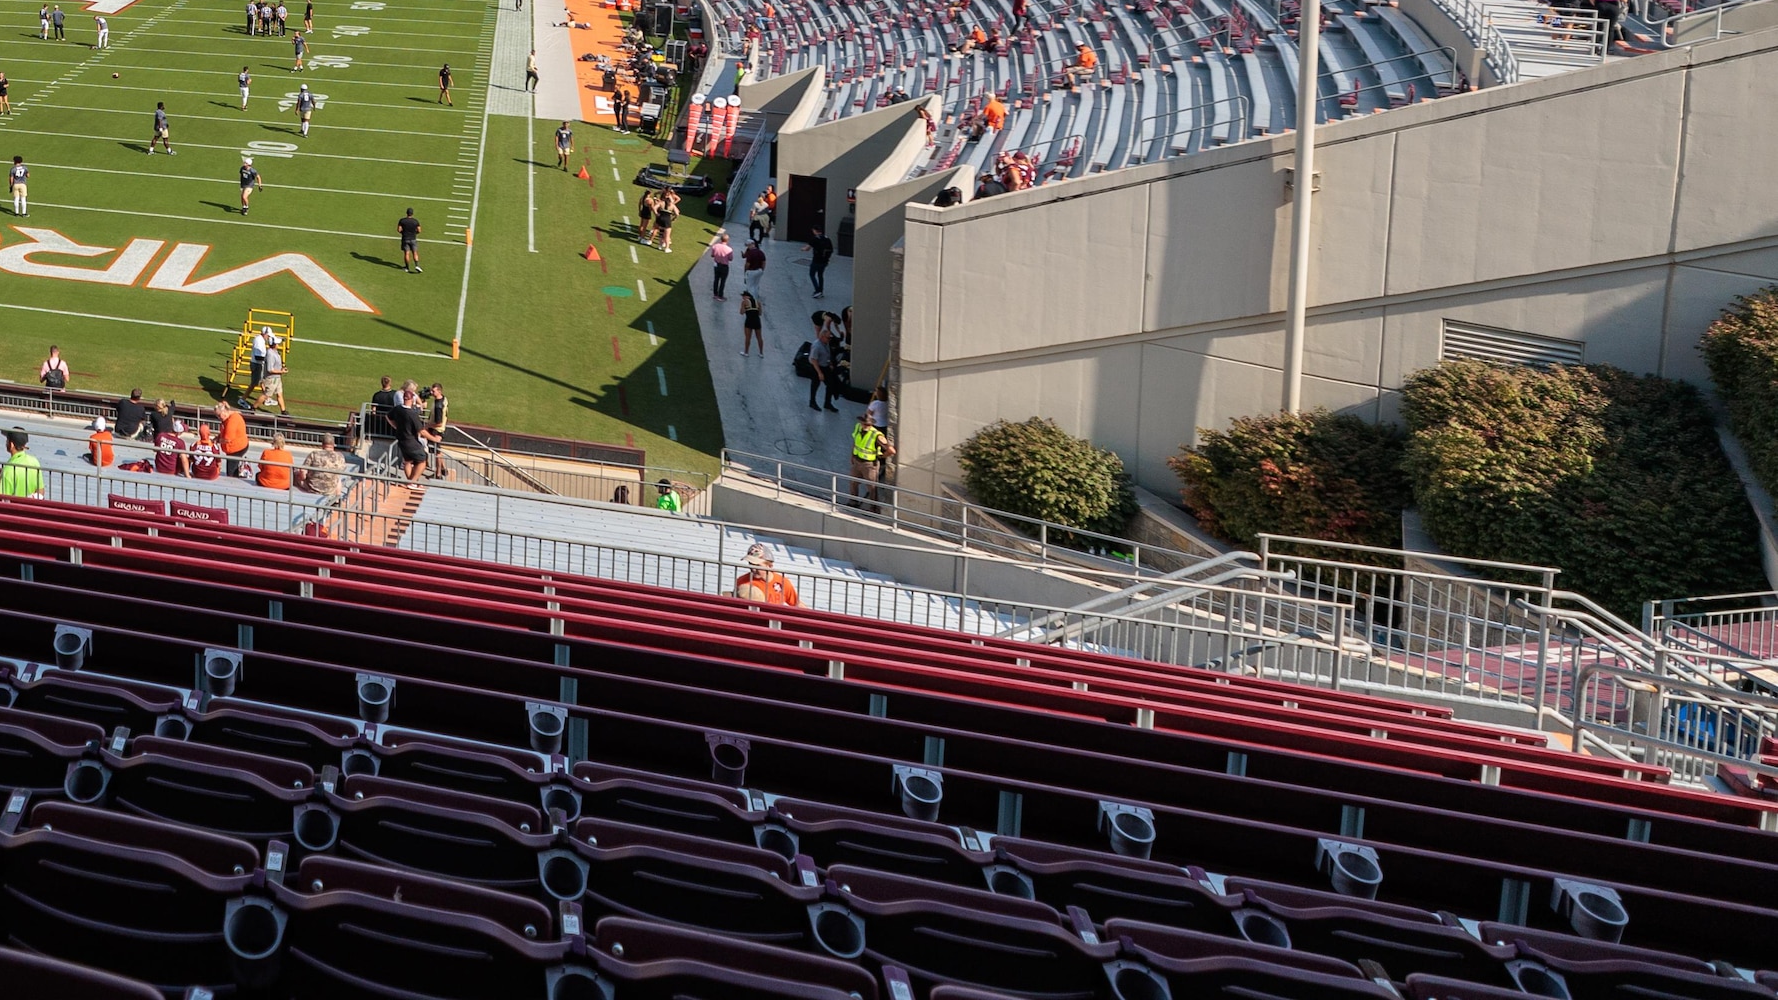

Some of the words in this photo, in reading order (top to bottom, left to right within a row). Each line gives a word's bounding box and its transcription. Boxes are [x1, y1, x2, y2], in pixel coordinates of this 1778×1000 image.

[241, 140, 298, 159] 10
[15, 169, 25, 177] 47
[194, 450, 214, 467] 99
[113, 500, 146, 512] GRAND
[177, 508, 209, 521] GRAND
